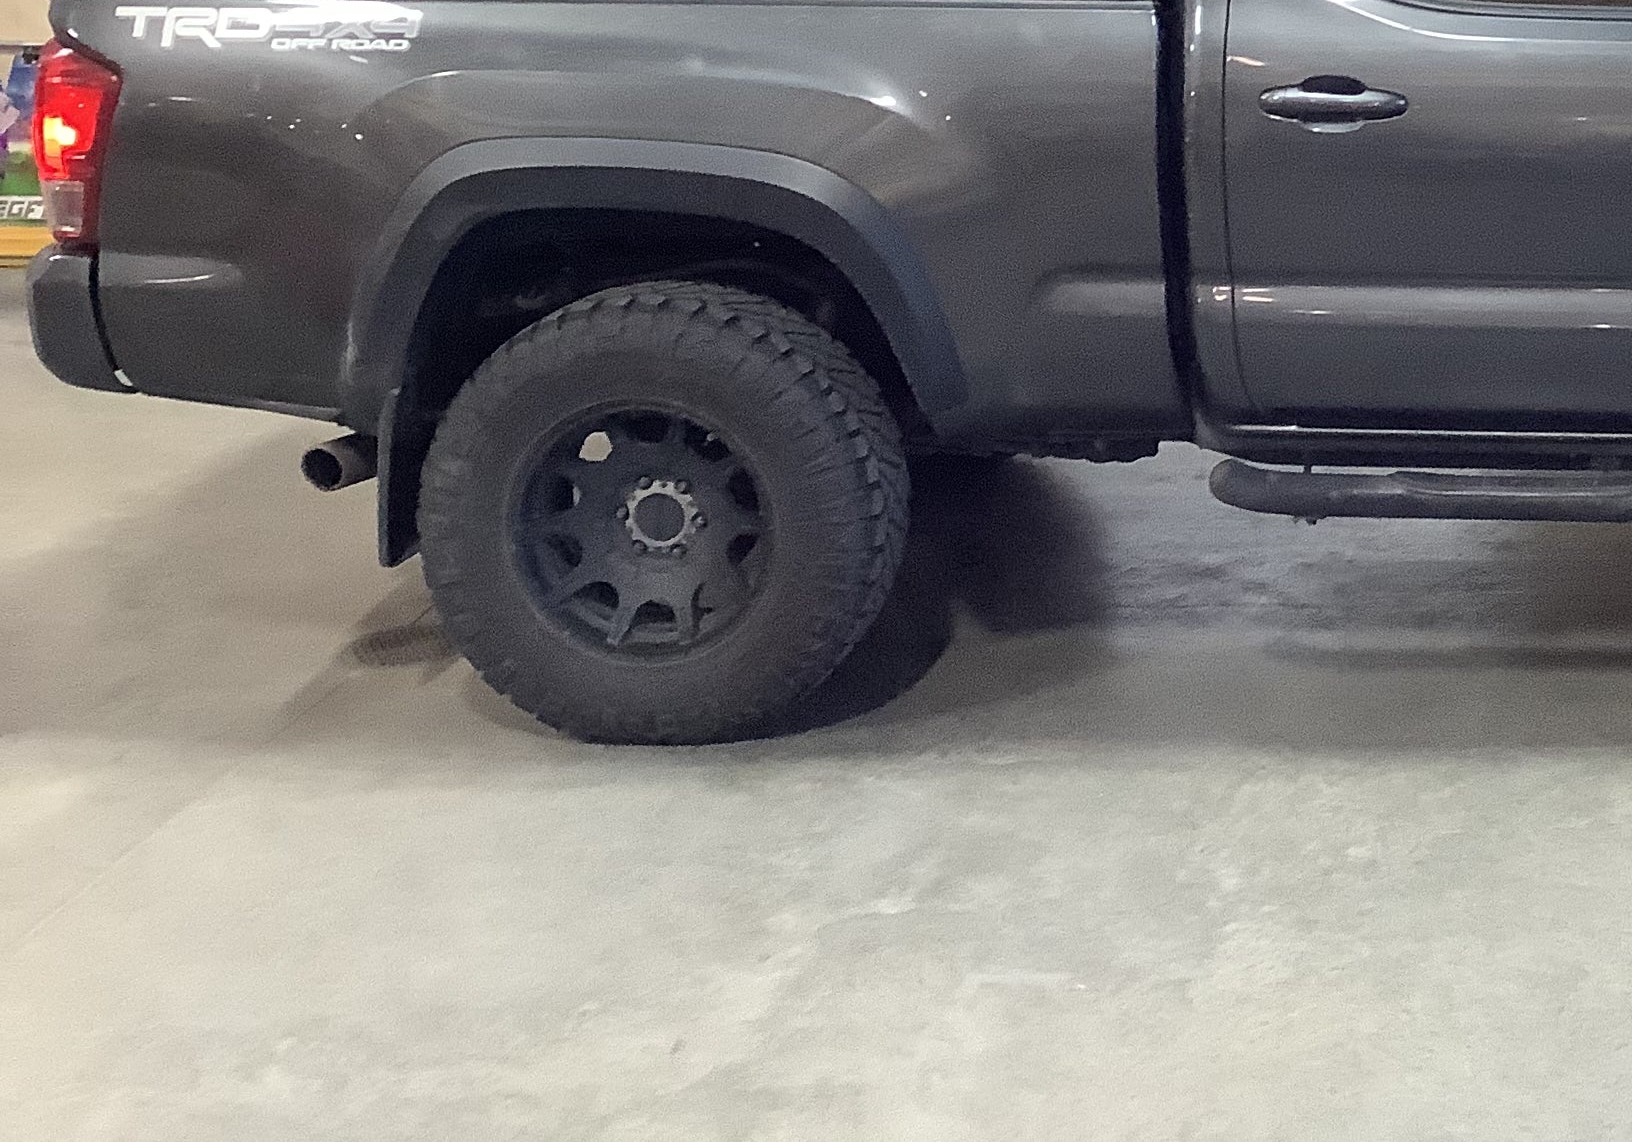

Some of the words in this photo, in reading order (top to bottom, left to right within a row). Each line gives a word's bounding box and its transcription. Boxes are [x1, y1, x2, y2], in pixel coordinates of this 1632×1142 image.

[115, 5, 272, 48] TRD
[270, 38, 327, 50] OFF
[331, 38, 411, 51] ROAD
